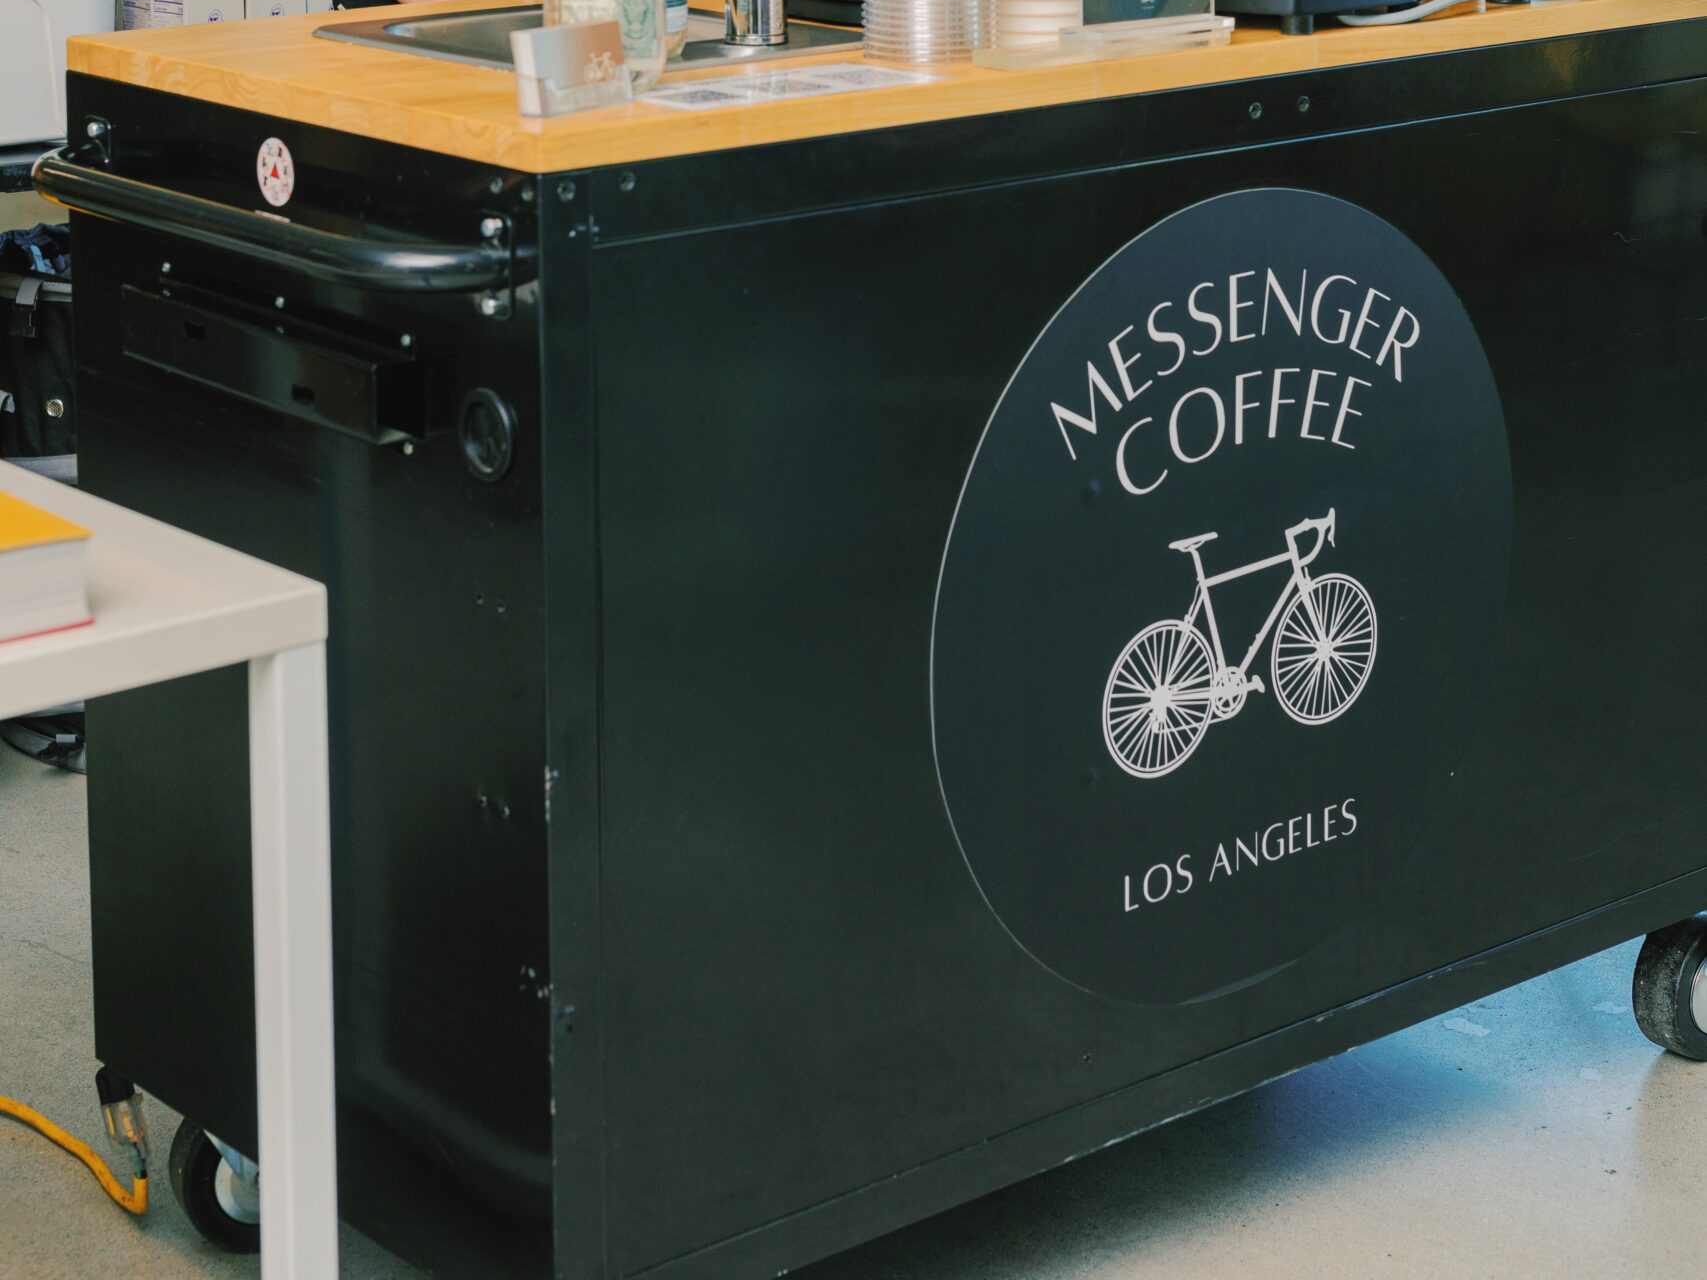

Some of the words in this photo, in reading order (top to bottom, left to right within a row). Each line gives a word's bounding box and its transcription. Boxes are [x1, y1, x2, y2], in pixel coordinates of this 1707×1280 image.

[1050, 267, 1421, 461] MESSENGER
[1115, 367, 1373, 496] COFFEE
[1123, 853, 1194, 913] LOS
[1208, 797, 1358, 883] ANGELES
